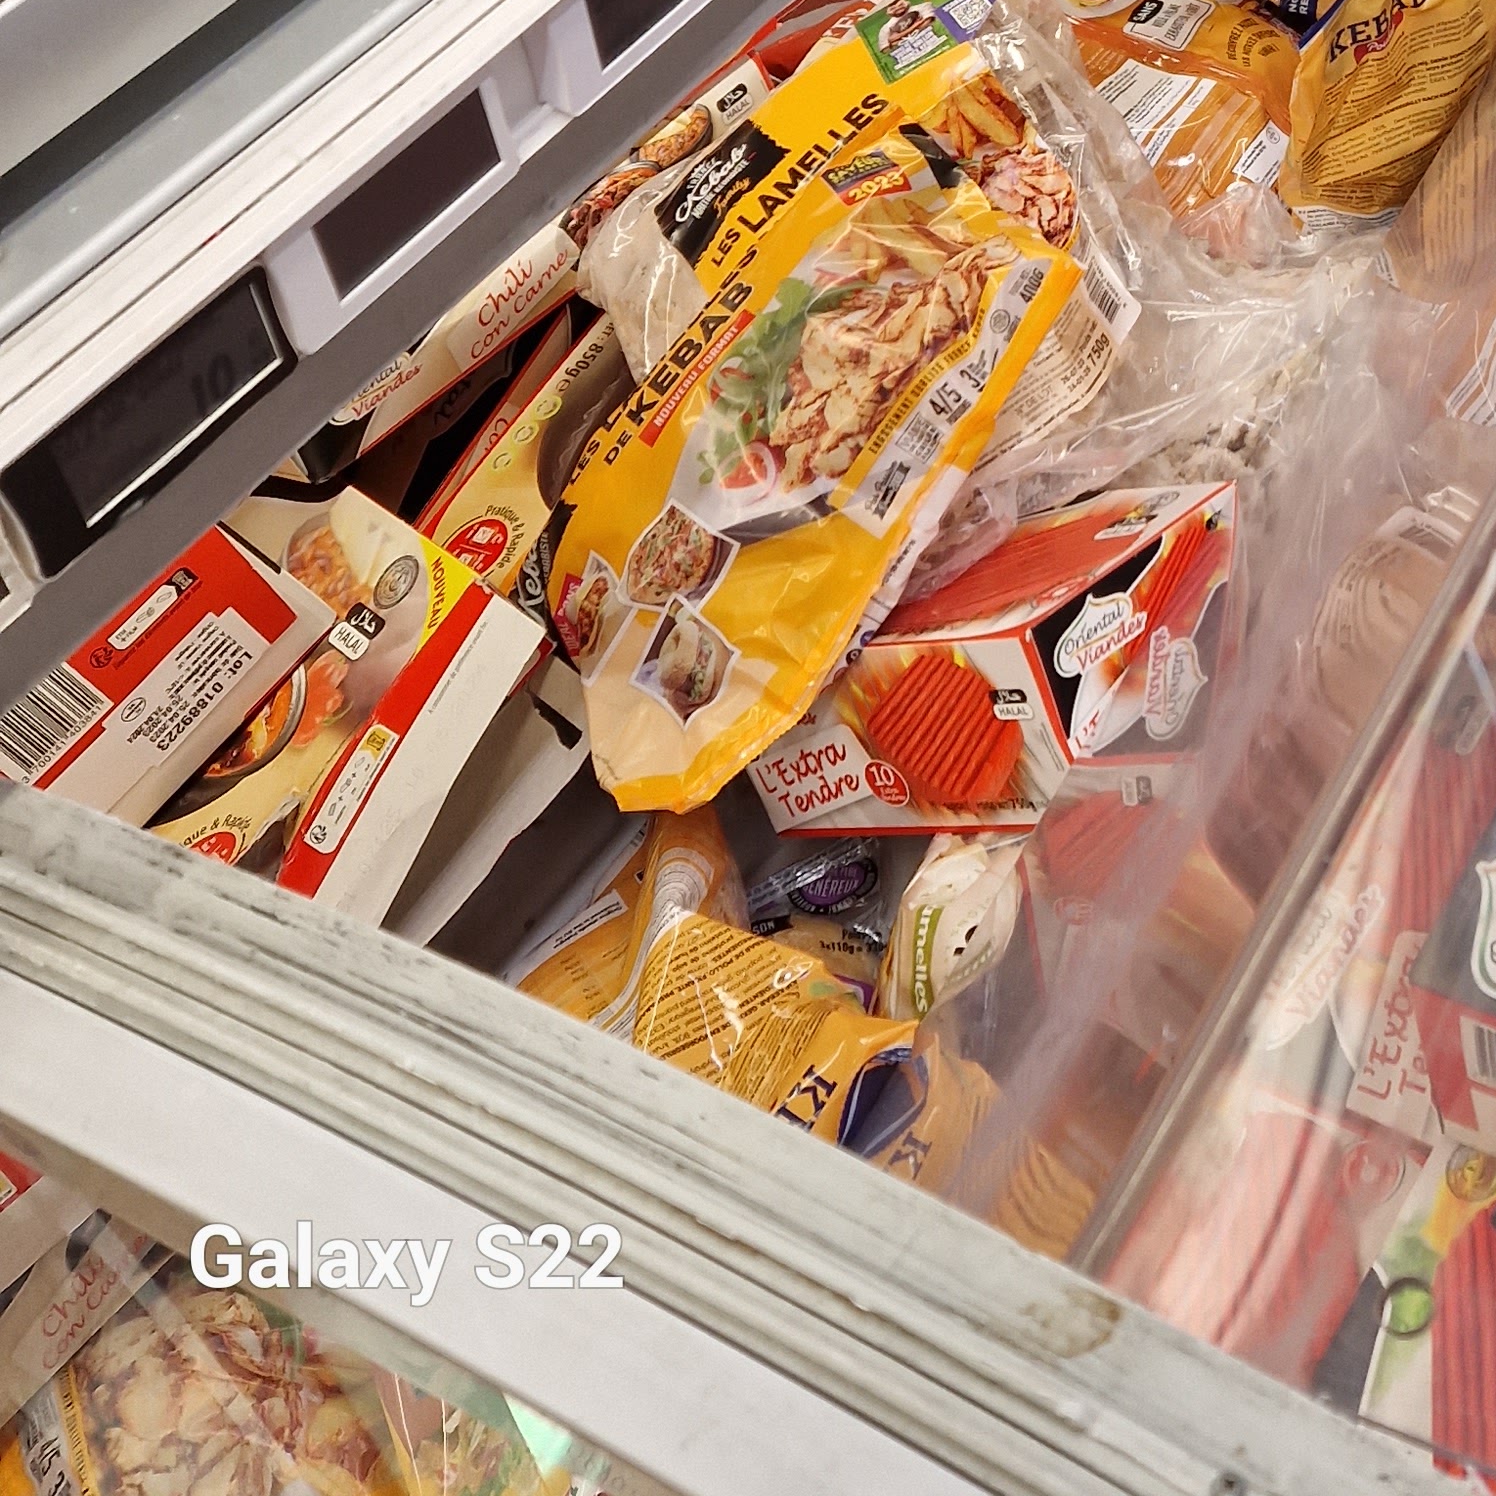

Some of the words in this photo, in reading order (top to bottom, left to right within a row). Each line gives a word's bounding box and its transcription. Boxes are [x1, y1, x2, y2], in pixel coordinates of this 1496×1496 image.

[1133, 1, 1159, 24] SANS
[849, 170, 905, 201] 2023
[712, 229, 741, 267] LES
[470, 315, 511, 361] con
[513, 248, 569, 315] Carne
[477, 258, 533, 327] Chili
[1087, 332, 1110, 368] 750g
[350, 362, 424, 419] Viandes
[603, 431, 632, 466] DE
[626, 282, 753, 427] KEBAB
[654, 369, 699, 428] NOUVEAU
[698, 326, 739, 371] FORMAT
[959, 367, 981, 390] 3
[928, 382, 962, 418] 4/5
[485, 504, 521, 526] Pratique
[497, 531, 525, 570] Rapide
[427, 555, 446, 630] NOUVEAU
[333, 624, 364, 656] HALAL
[1063, 604, 1124, 655] Oriental
[1075, 615, 1145, 670] Viandes
[222, 650, 252, 681] Lot:
[154, 680, 224, 752] 01889223
[997, 706, 1029, 717] HALAL
[21, 775, 31, 784] 3
[28, 739, 69, 774] 700141
[65, 704, 104, 738] 403841
[756, 742, 847, 794] L'Extra
[868, 765, 895, 787] 10
[778, 773, 860, 818] Tendre
